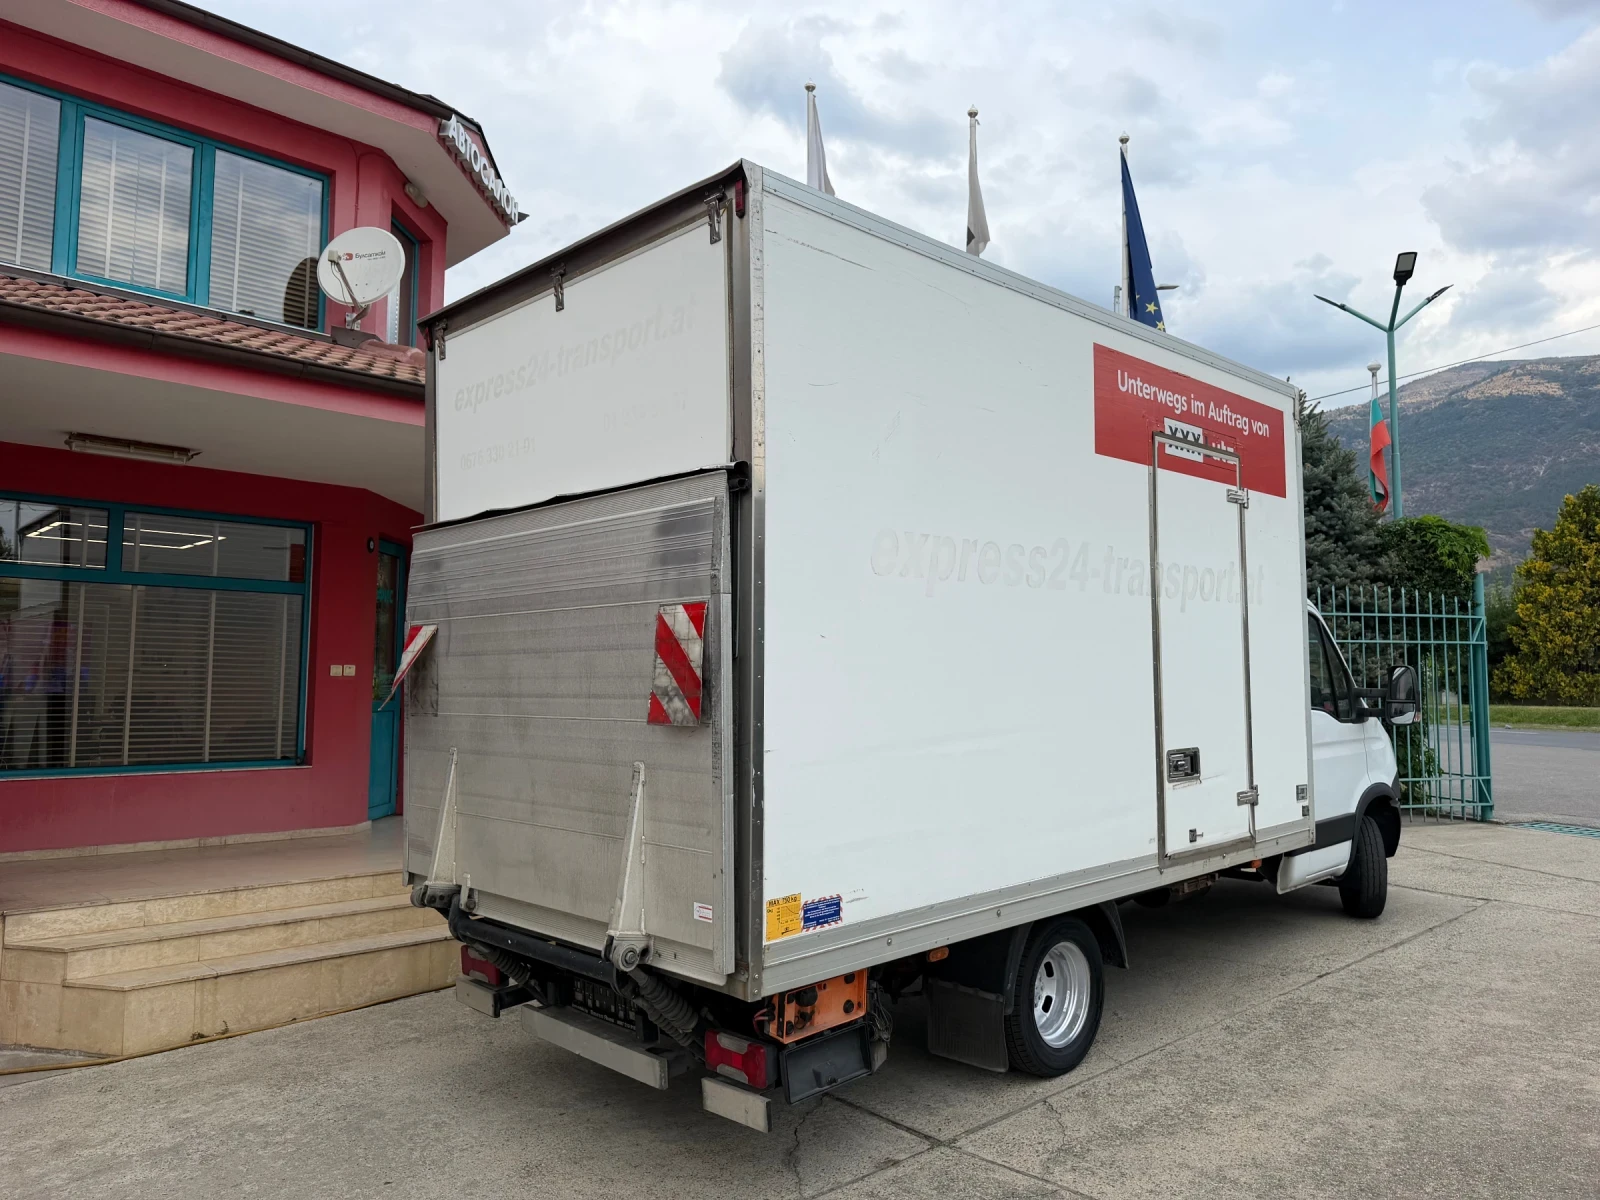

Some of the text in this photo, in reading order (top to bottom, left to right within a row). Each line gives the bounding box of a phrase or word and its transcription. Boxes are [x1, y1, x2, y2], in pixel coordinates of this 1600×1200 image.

[1117, 369, 1270, 438] Unterwegs im Auftrag von
[768, 899, 780, 907] MAX
